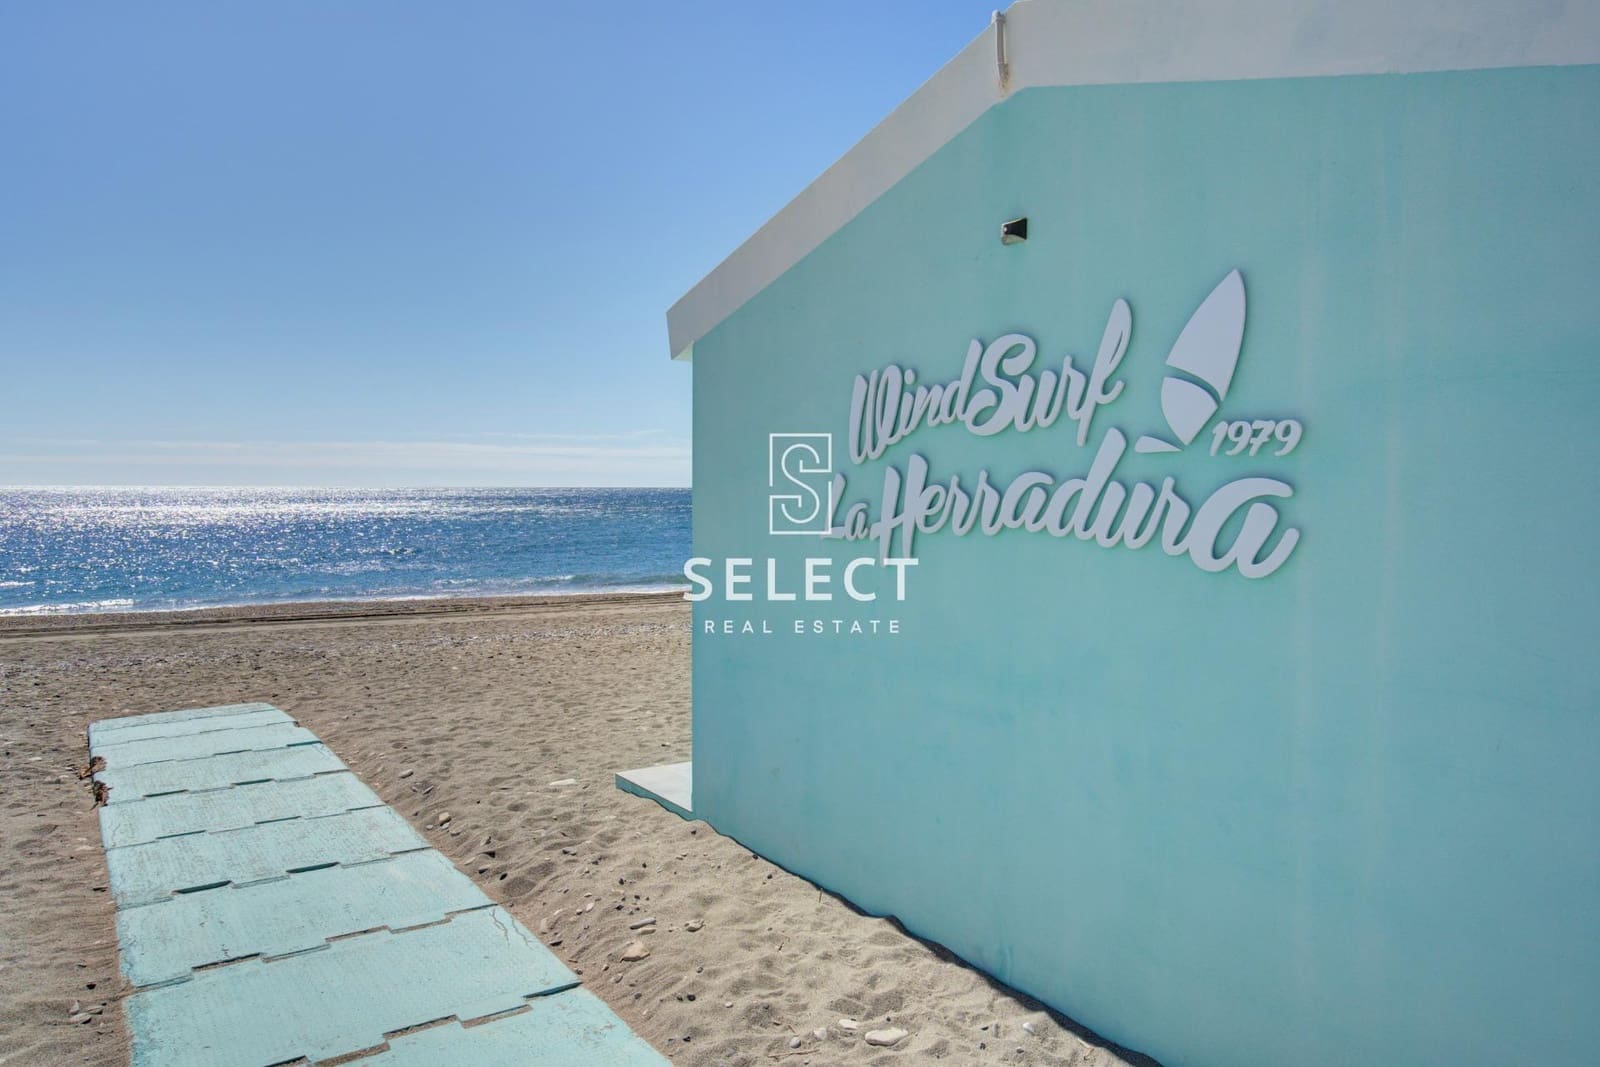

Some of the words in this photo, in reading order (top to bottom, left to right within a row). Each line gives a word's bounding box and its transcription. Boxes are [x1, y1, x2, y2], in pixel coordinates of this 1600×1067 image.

[848, 298, 1132, 465] WindSurf
[1210, 419, 1302, 458] 1979
[820, 473, 869, 541] La
[869, 427, 1300, 579] Herradura
